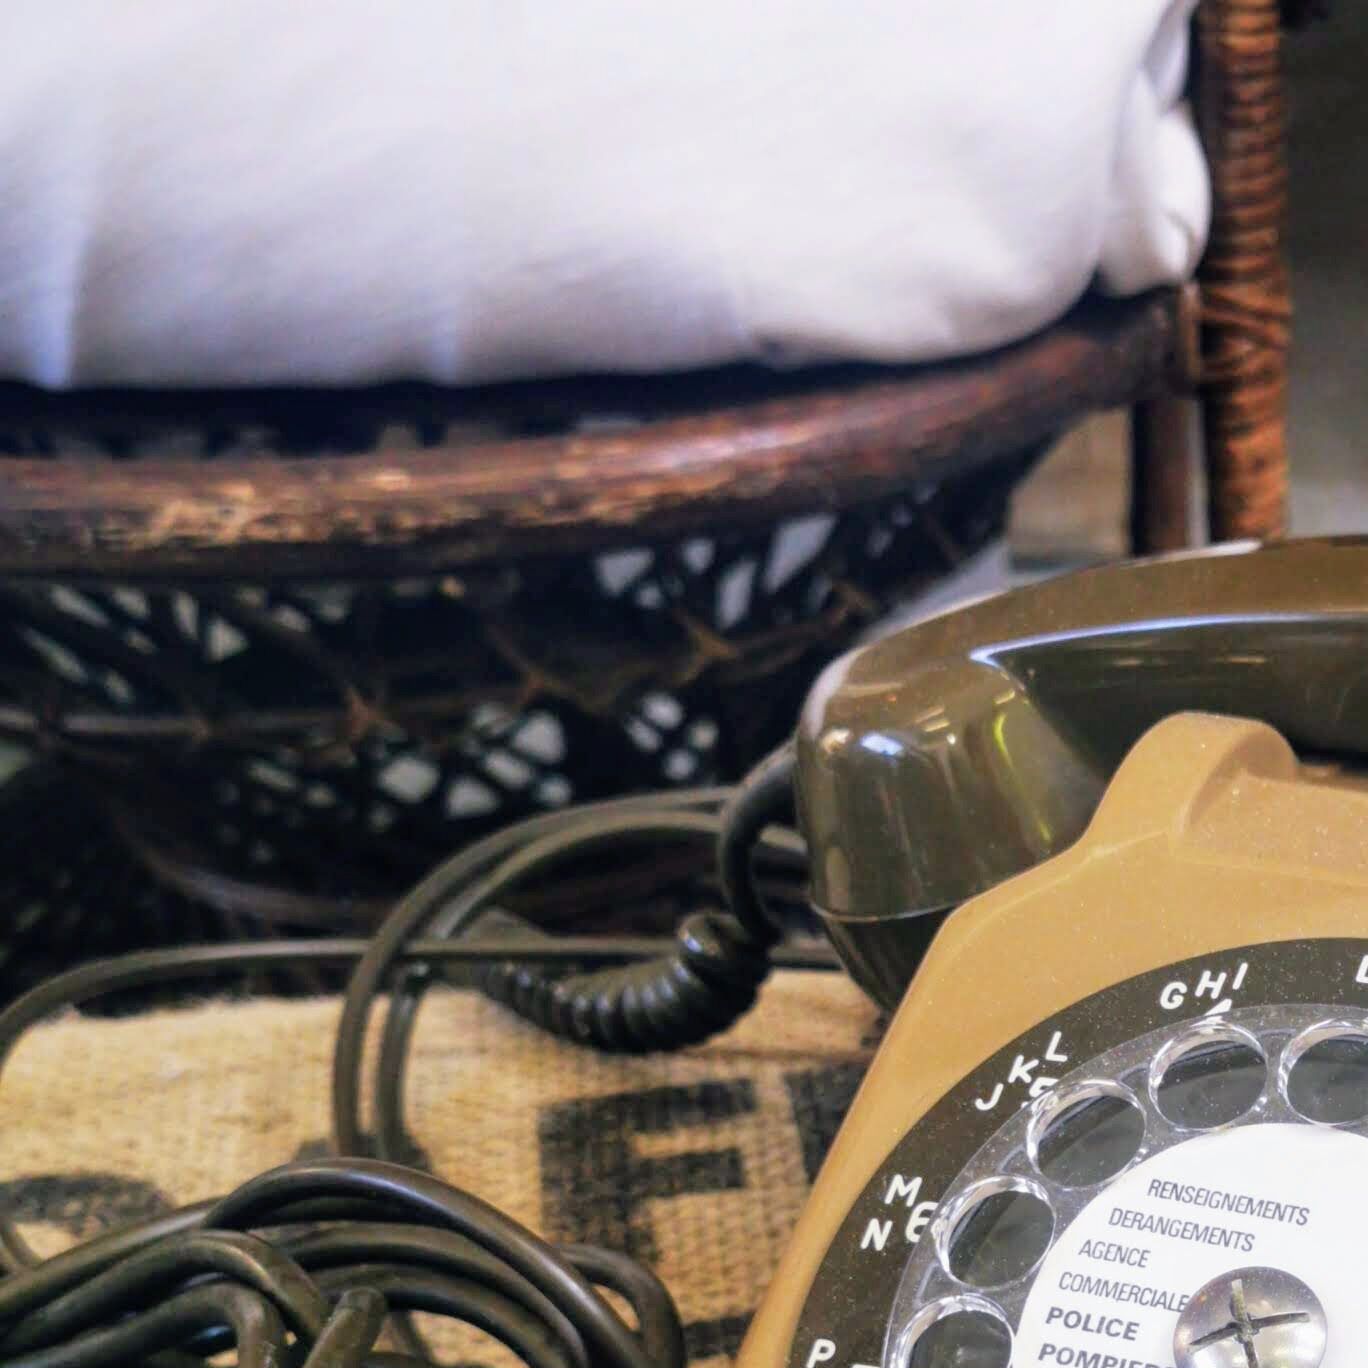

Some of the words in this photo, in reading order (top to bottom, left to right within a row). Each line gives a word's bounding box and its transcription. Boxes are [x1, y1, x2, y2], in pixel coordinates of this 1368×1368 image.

[1159, 962, 1249, 1010] GHI
[974, 1030, 1069, 1112] JKL
[1146, 1177, 1311, 1227] RENSEIGNEMENTS
[1107, 1206, 1256, 1253] DERANGEMENTS
[1077, 1238, 1152, 1269] AGENCE
[1057, 1270, 1191, 1314] COMMERCIALE
[1044, 1305, 1141, 1342] POLICE
